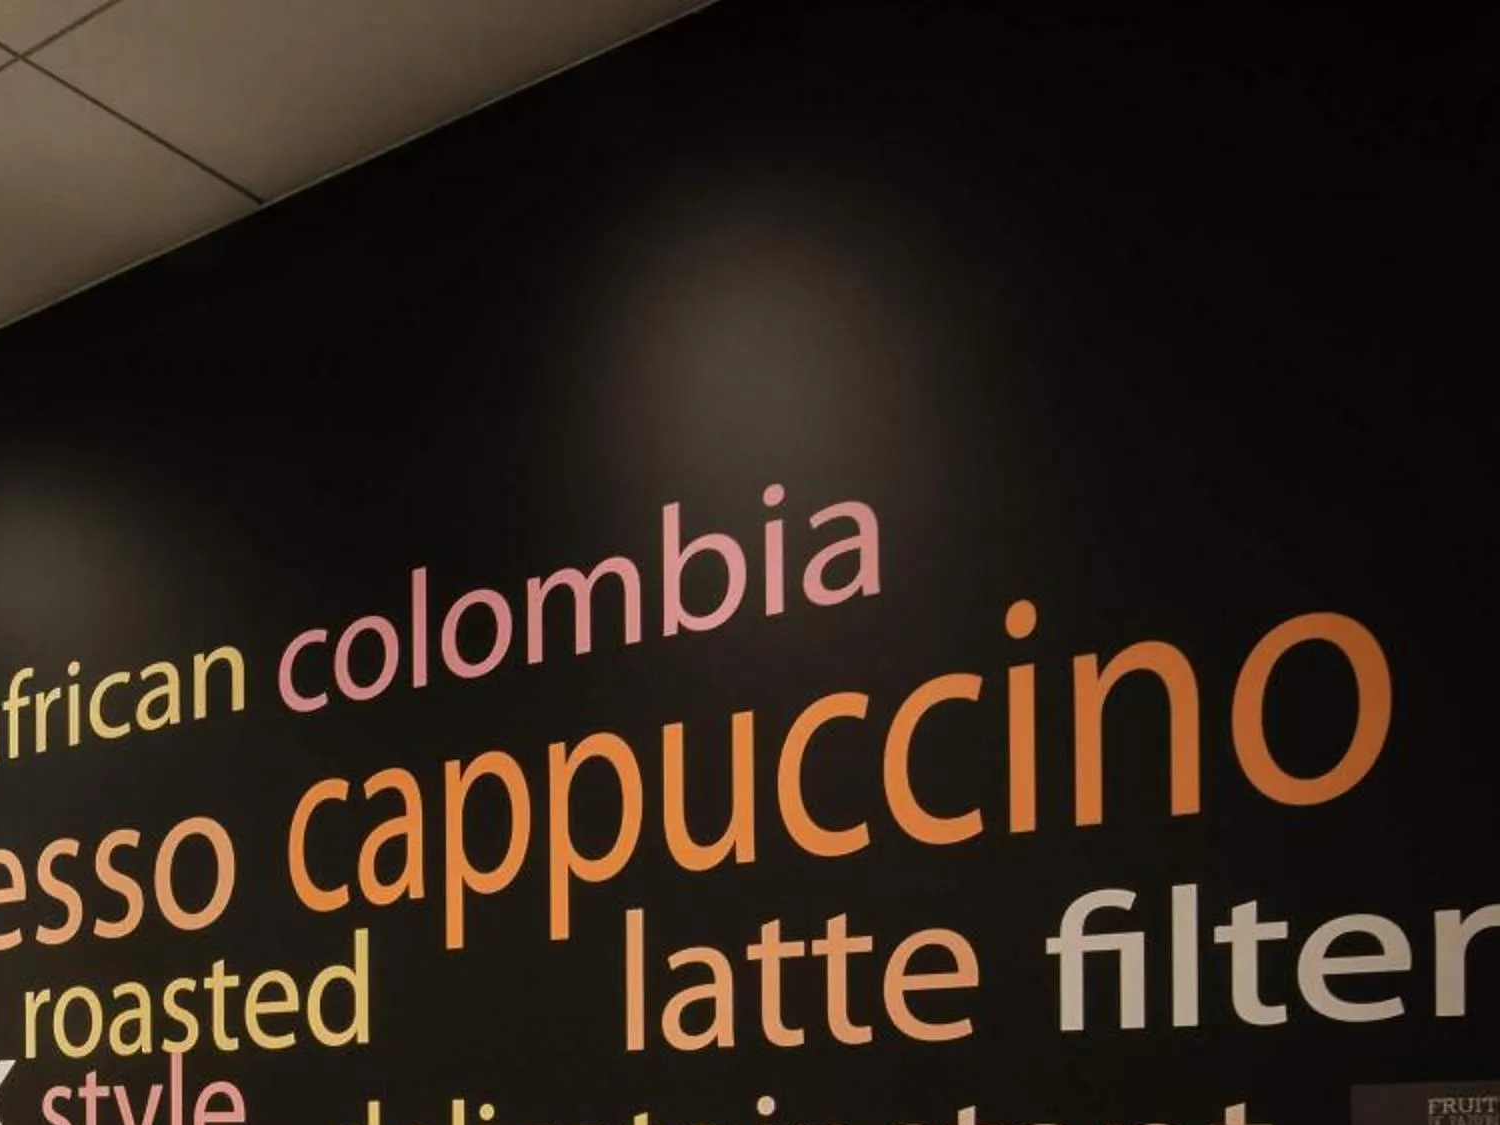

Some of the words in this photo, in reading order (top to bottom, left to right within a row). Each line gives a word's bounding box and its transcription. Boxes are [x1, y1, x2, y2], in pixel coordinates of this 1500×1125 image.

[277, 482, 881, 713] colombia
[288, 600, 1391, 950] cappuccino
[24, 927, 370, 1059] roasted
[625, 908, 979, 1051] latte
[1045, 883, 1500, 1032] filter
